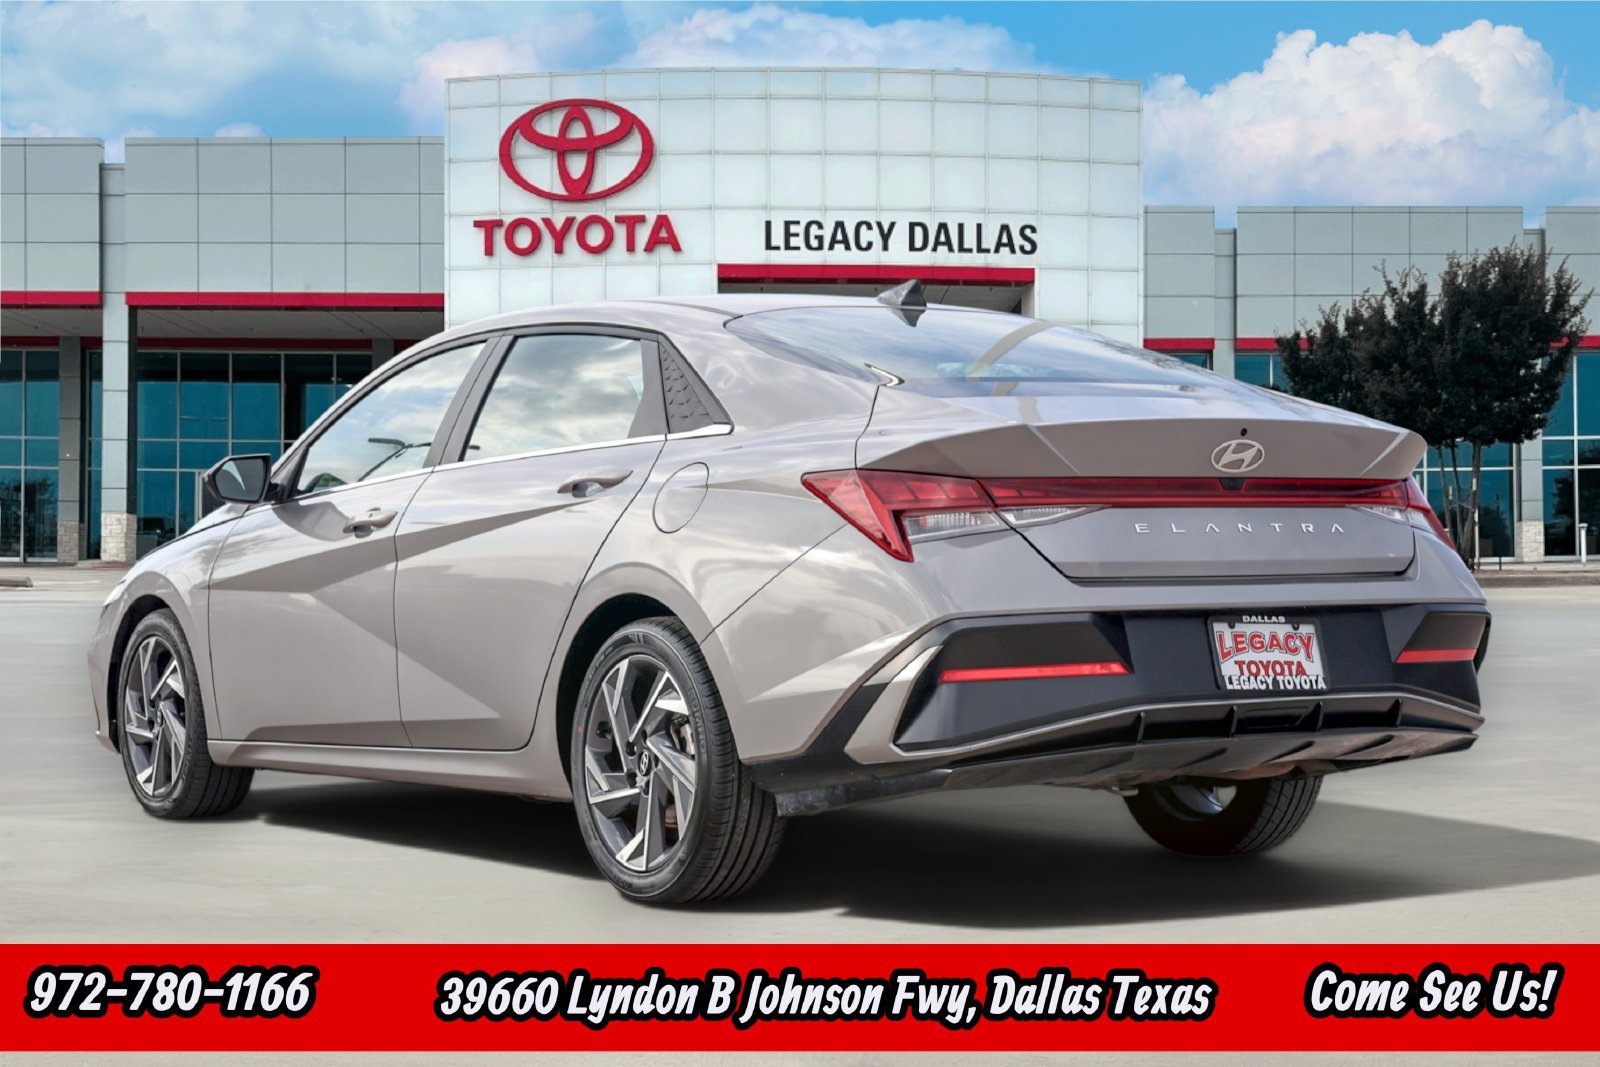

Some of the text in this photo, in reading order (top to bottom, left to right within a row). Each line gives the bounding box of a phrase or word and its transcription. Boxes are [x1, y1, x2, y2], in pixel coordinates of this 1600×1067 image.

[474, 214, 682, 257] TOYOTA
[764, 220, 1038, 255] LEGACY DALLAS
[1134, 522, 1345, 534] ELANTRA
[1242, 615, 1286, 623] DALLAS
[1216, 630, 1315, 664] LEGACY
[1234, 660, 1308, 676] TOYOTA
[1224, 675, 1327, 690] LEGACY TOYOTA
